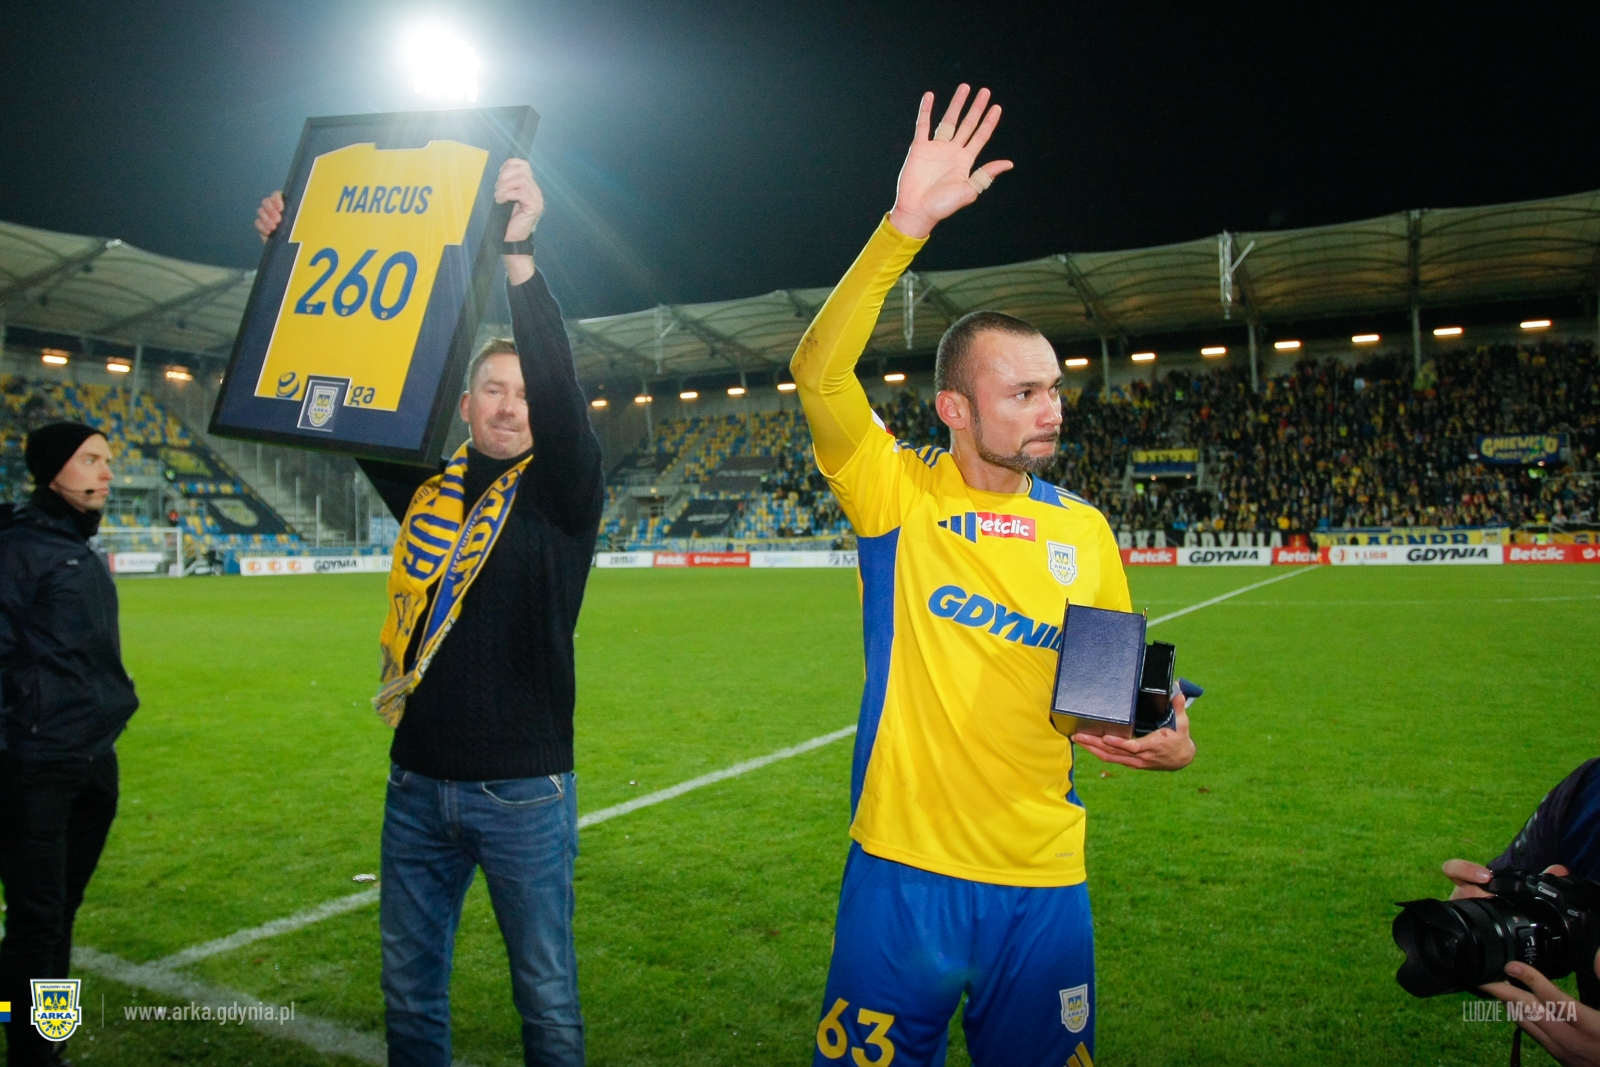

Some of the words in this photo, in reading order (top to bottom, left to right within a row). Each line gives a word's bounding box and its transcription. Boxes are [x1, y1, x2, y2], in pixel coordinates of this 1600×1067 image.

[335, 185, 432, 214] MARCUS
[294, 247, 417, 321] 260
[349, 385, 376, 406] ga
[1118, 530, 1167, 548] RKA
[1184, 531, 1283, 548] GDYNIA
[1130, 551, 1172, 563] Betclic
[1189, 550, 1259, 563] GDYNIA
[1407, 548, 1489, 562] GDYNIA
[1510, 547, 1565, 561] Betclic
[314, 560, 357, 571] GDYNIA
[1538, 886, 1557, 898] Canon
[1567, 909, 1579, 917] EOS
[817, 997, 895, 1067] 63
